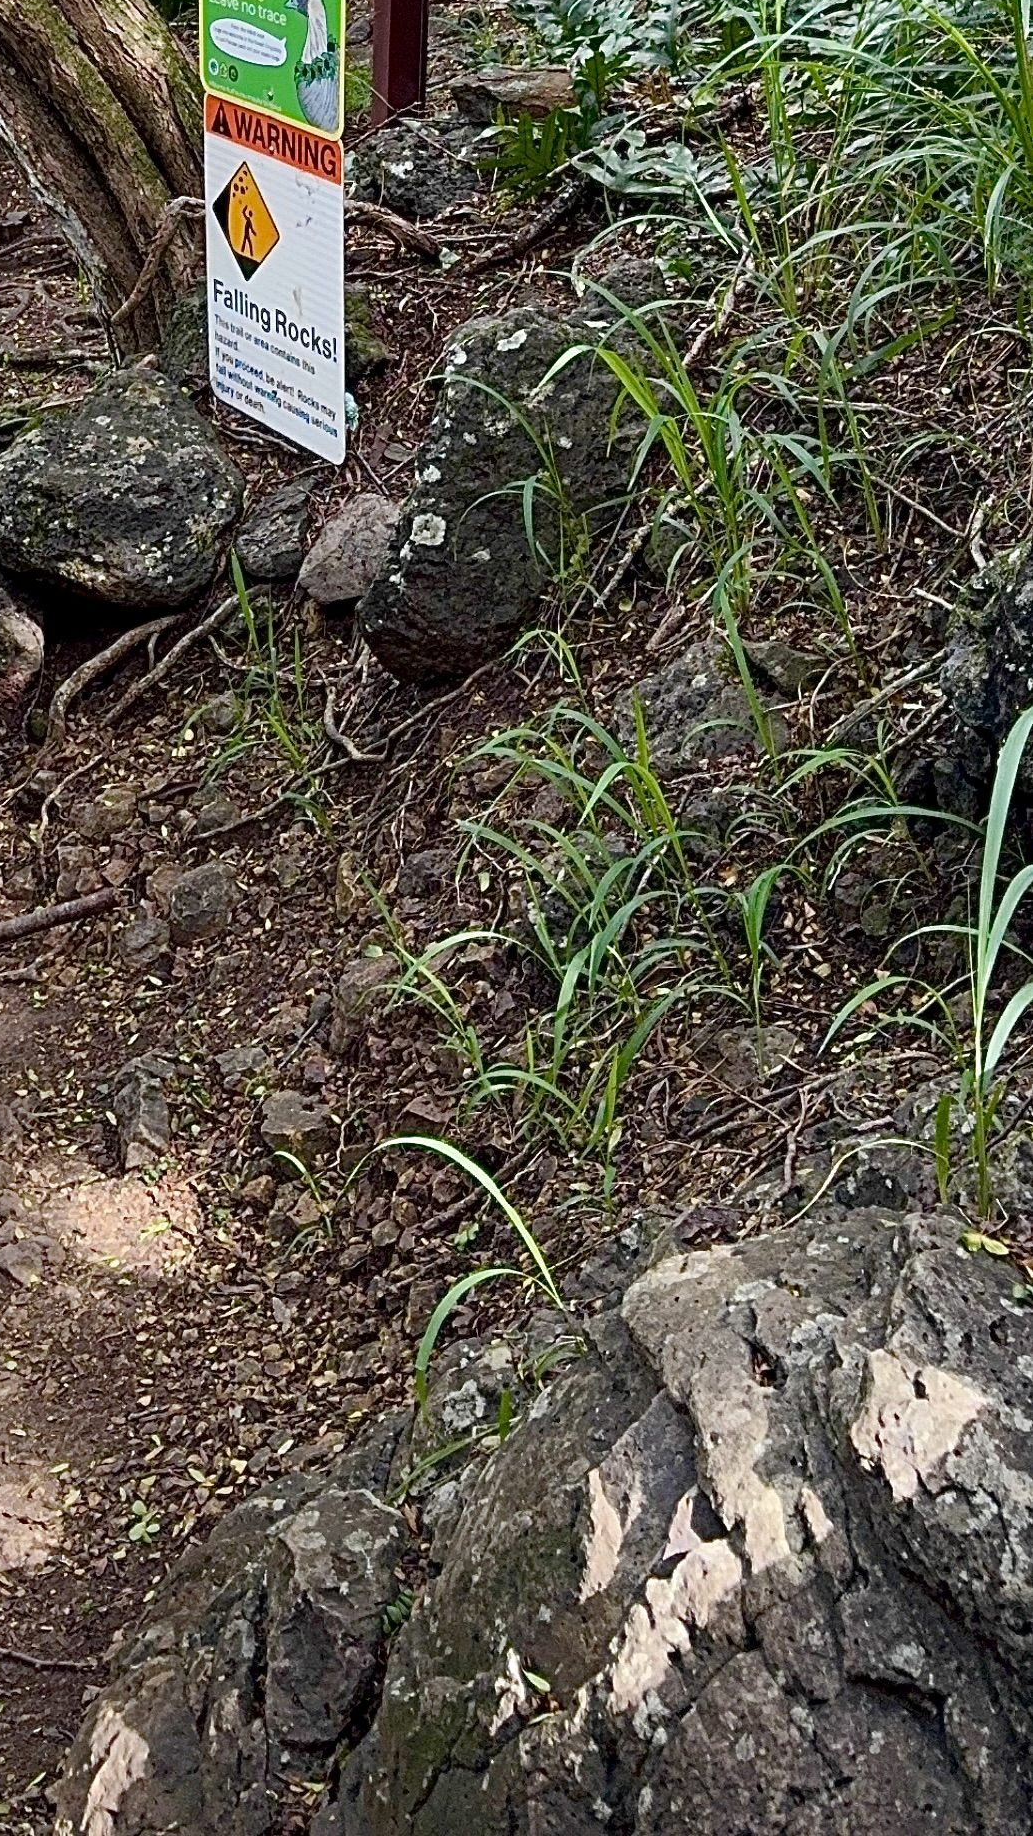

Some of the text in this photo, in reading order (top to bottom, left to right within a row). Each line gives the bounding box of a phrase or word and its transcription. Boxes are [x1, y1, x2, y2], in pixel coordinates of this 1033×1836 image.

[241, 2, 256, 16] no
[258, 6, 287, 26] trace
[233, 108, 336, 178] WARNING
[213, 278, 337, 363] Falling Rocks!
[214, 314, 229, 331] This
[230, 324, 244, 338] trail
[253, 336, 268, 352] area
[270, 343, 300, 368] contains
[302, 358, 315, 375] this
[221, 351, 234, 366] you
[265, 372, 275, 387] be
[297, 389, 320, 411] Rocks
[320, 404, 336, 421] may
[228, 369, 253, 391] without
[283, 400, 310, 424] causing
[311, 415, 338, 438] serious
